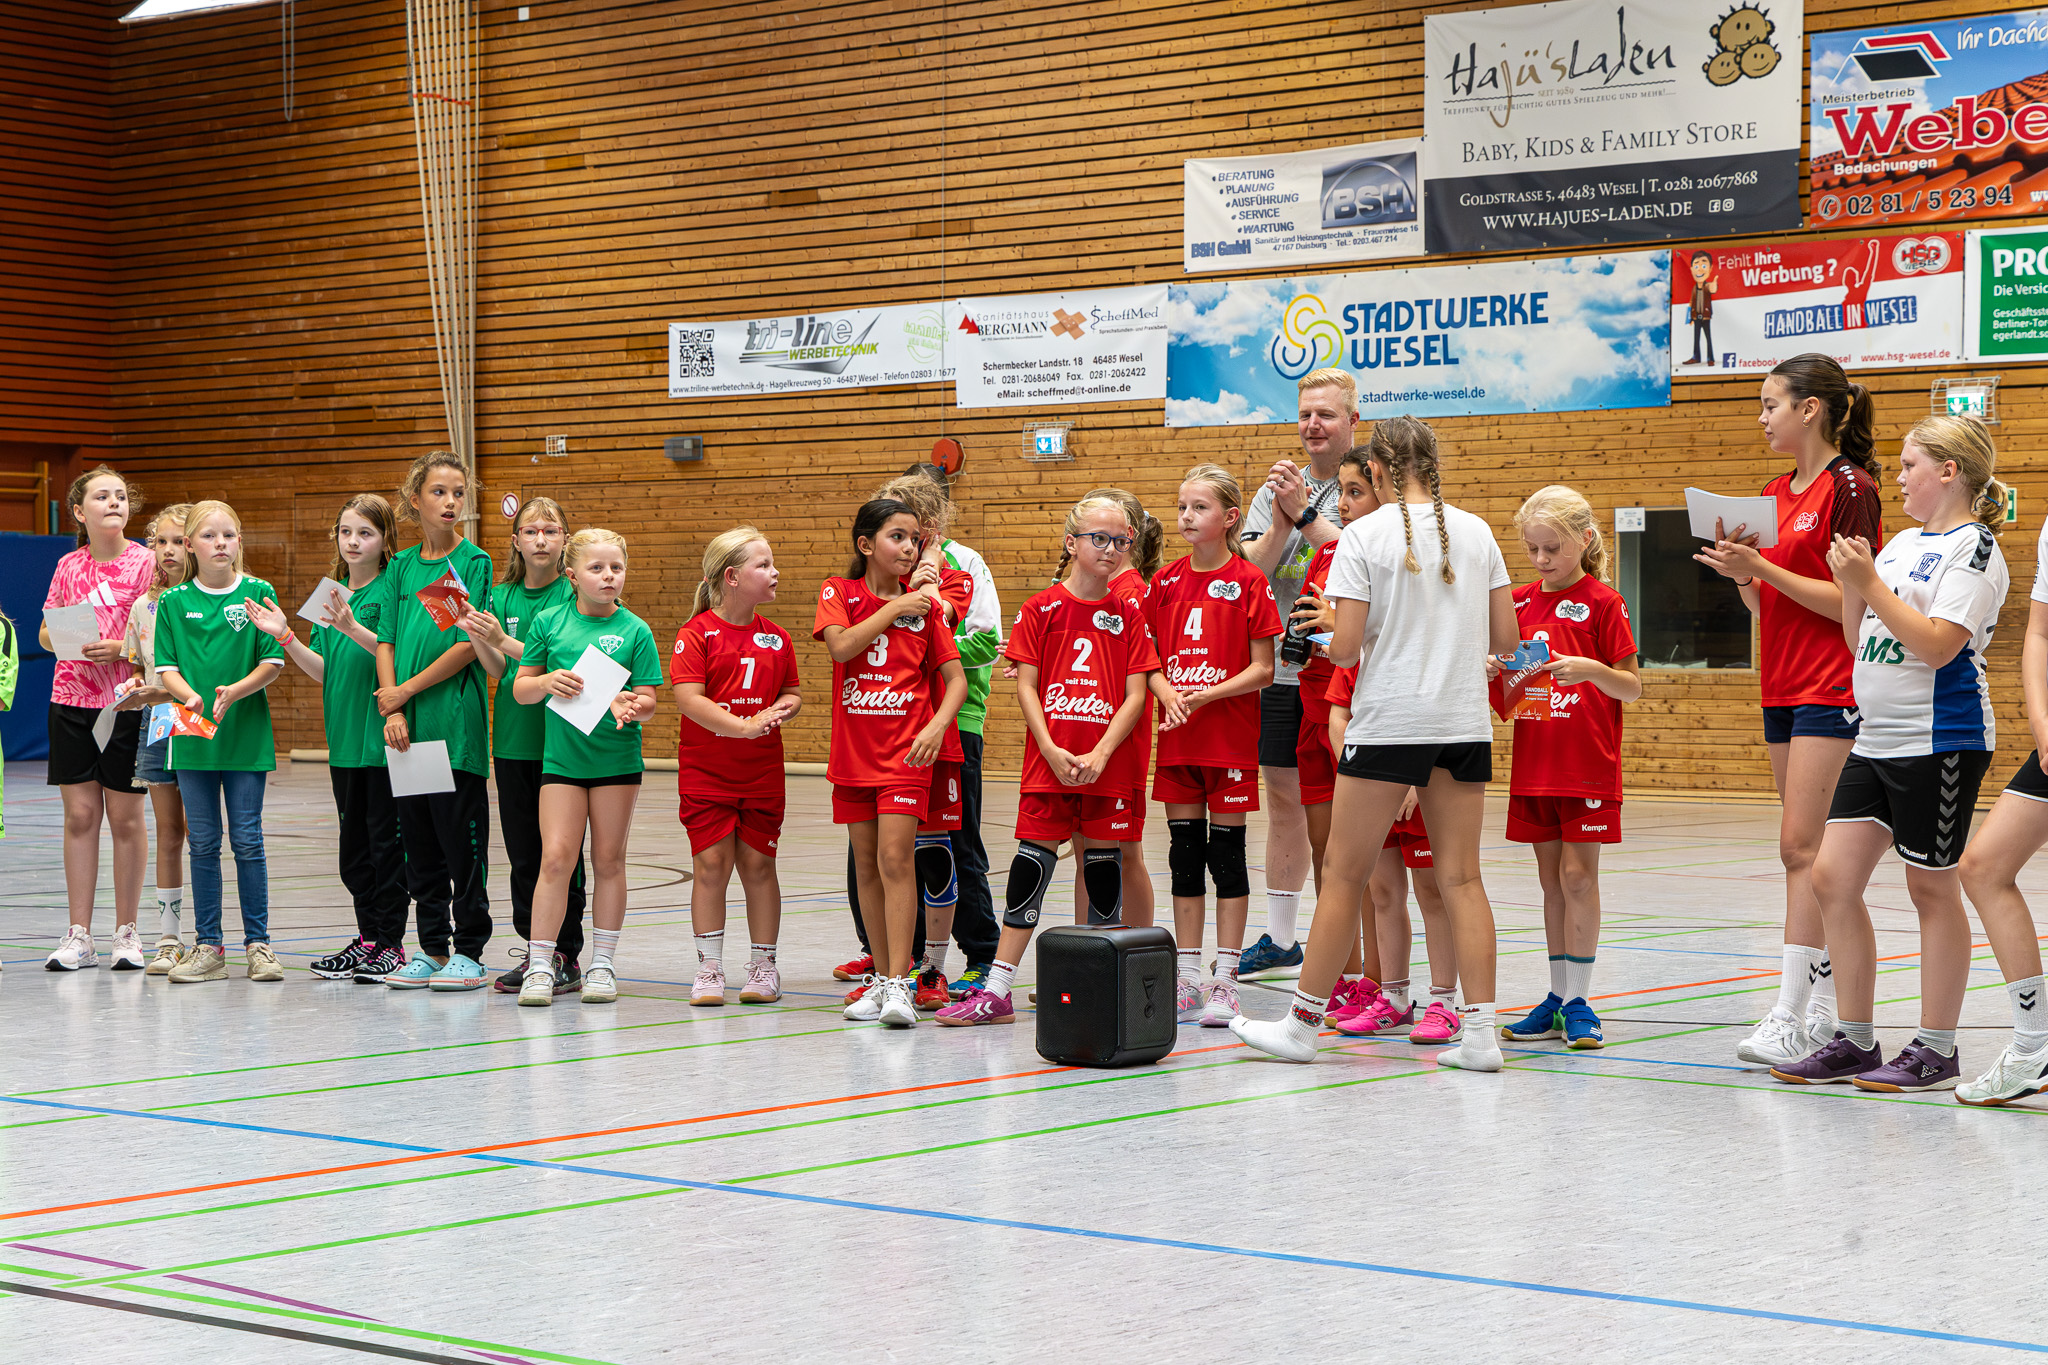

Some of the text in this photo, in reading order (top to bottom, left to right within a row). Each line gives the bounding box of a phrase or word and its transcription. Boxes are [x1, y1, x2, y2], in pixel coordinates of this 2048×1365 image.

[1957, 27, 1984, 50] Ihr
[1511, 100, 1544, 110] RICHTIG
[1546, 98, 1572, 107] GUTES
[1574, 93, 1617, 105] SPIELZEUG
[1619, 92, 1638, 100] UND
[1822, 87, 1915, 104] Meisterbetrieb
[1462, 122, 1758, 163] BABY, KIDS & FAMILY STORE
[1218, 169, 1275, 182] BERATUNG
[1834, 158, 1938, 176] Bedachungen
[1225, 182, 1275, 195] PLANUNG
[1459, 189, 1543, 206] GOLDSTRASSE
[1558, 184, 1596, 202] 46483
[1598, 181, 1639, 197] WESEL
[1648, 178, 1662, 192] T.
[1664, 176, 1694, 192] 0281
[1696, 170, 1759, 190] 20677868
[1231, 193, 1299, 208] AUSFÜHRUNG
[1333, 184, 1405, 220] BSH
[1847, 195, 1873, 216] 02
[1880, 192, 1904, 213] 81
[1928, 189, 1942, 210] 5
[1949, 187, 1977, 209] 23
[1983, 184, 2013, 206] 94
[1239, 208, 1280, 220] SERVICE
[1483, 201, 1693, 230] WWW.HAJUES-LADEN.DE
[1242, 222, 1294, 234] WARTUNG
[1255, 236, 1281, 245] Sanitär
[1282, 235, 1295, 243] und
[1297, 231, 1354, 242] Heizungstechnik
[1296, 241, 1327, 251] Duisburg
[1385, 235, 1398, 243] 214
[1191, 238, 1251, 258] BSH GmbH
[1901, 243, 1941, 264] HSG
[1718, 250, 1781, 270] Fehlt Ihre
[1742, 264, 1824, 288] Werbung
[1993, 284, 2013, 296] Die
[976, 310, 1049, 322] Sanitätshaus
[1090, 305, 1159, 331] ScheffMed
[1342, 291, 1549, 335] STADTWERKE
[1765, 297, 1917, 338] HANDBALL IN WESEL
[745, 316, 852, 350] tri-line
[977, 321, 1048, 336] BERGMANN
[789, 342, 879, 360] WERBETECHNIK
[1350, 334, 1459, 370] WESEL
[1861, 349, 1951, 364] www.hsg-wesel.de
[983, 353, 1143, 371] Schermbecker Landstr. 18 46485 Wesel
[672, 382, 765, 393] www.triline-werbetechnik.de
[769, 378, 821, 390] Hagelkreuzweg
[822, 377, 832, 385] 50
[836, 375, 857, 384] 46487
[858, 373, 879, 383] Wesel
[884, 371, 909, 381] Telefon
[910, 369, 932, 379] 02803
[939, 367, 956, 377] 1677
[983, 376, 996, 385] Tel.
[1066, 371, 1084, 381] Fax.
[1089, 367, 1146, 380] 0281-2062422
[997, 383, 1131, 399] eMail: scheffmed@t-online.de
[1184, 607, 1203, 640] 4
[867, 633, 889, 667] 3
[1071, 637, 1093, 672] 2
[740, 657, 755, 689] 7
[874, 673, 892, 682] 1948
[1080, 678, 1098, 686] 1948
[1508, 658, 1545, 688] URKUNDE
[842, 677, 915, 708] Benter
[1044, 682, 1114, 716] Benter
[847, 707, 907, 716] Backmanufaktur
[948, 778, 959, 802] 9
[894, 795, 917, 805] Kempa
[1224, 796, 1249, 804] Kempa
[942, 813, 959, 821] Kempa
[1111, 822, 1129, 830] Kempa
[1582, 824, 1608, 833] Kempa
[1295, 1007, 1320, 1023] HSG
